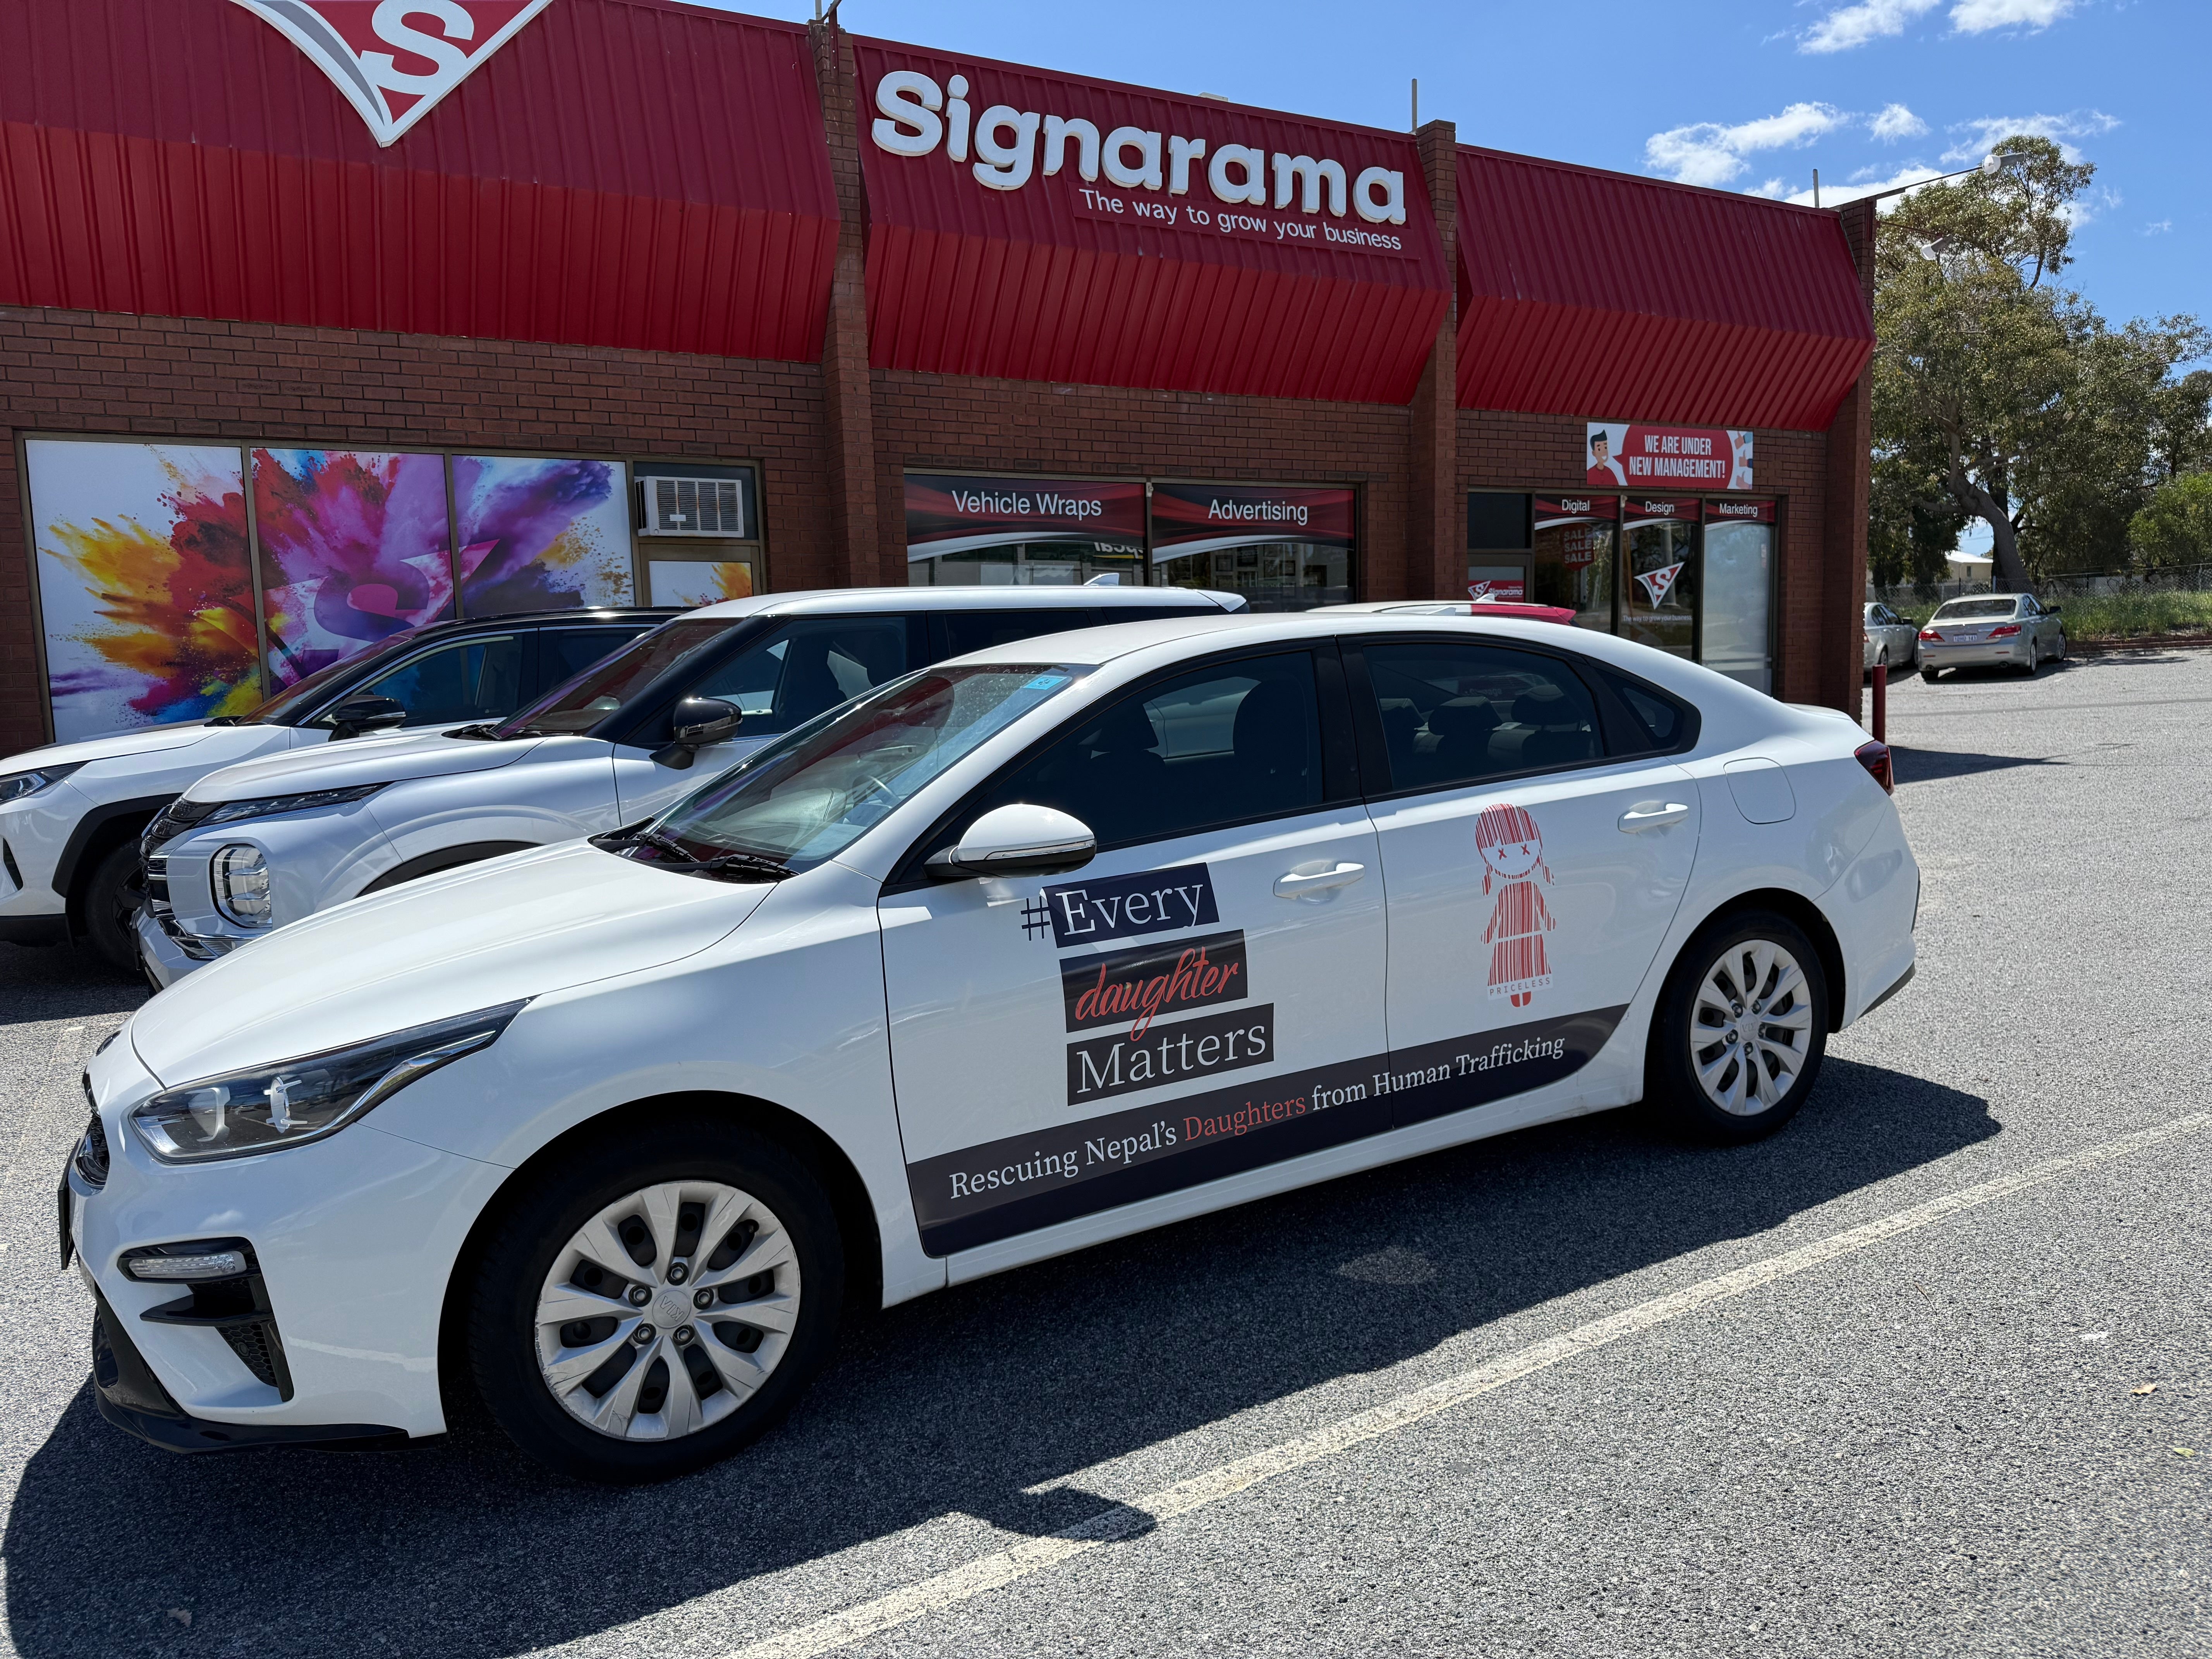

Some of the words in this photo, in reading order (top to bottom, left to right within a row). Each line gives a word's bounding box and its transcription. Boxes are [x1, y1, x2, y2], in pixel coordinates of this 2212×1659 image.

[871, 70, 1406, 225] Signarama
[1079, 189, 1124, 214] The
[1132, 201, 1177, 225] way
[1186, 206, 1210, 225] to
[1218, 213, 1266, 233] grow
[1273, 221, 1316, 240] your
[1323, 222, 1402, 250] business
[1644, 435, 1659, 453] WE
[1661, 436, 1679, 453] ARE
[1681, 437, 1711, 455] UNDER
[1629, 456, 1652, 476] NEW
[1654, 457, 1725, 478] MANAGEMENT!
[952, 491, 1030, 514] Vehicle
[1036, 493, 1102, 521] Wraps
[1208, 499, 1308, 526] Advertising
[1562, 499, 1590, 514] Digital
[1645, 501, 1674, 515] Design
[1719, 503, 1758, 517] Marketing
[1565, 539, 1592, 553] SALE
[1565, 551, 1592, 563] SALE
[1653, 569, 1671, 595] S
[1075, 946, 1238, 1041] daughter
[1490, 977, 1550, 996] PRICELESS
[1077, 1025, 1266, 1093] Matters
[950, 1151, 1079, 1199] Rescuing
[1183, 1097, 1306, 1141] Daughters
[1312, 1082, 1367, 1111] from
[1372, 1064, 1451, 1097] Human
[1456, 1037, 1565, 1077] Trafficking
[660, 1295, 684, 1321] KIA
